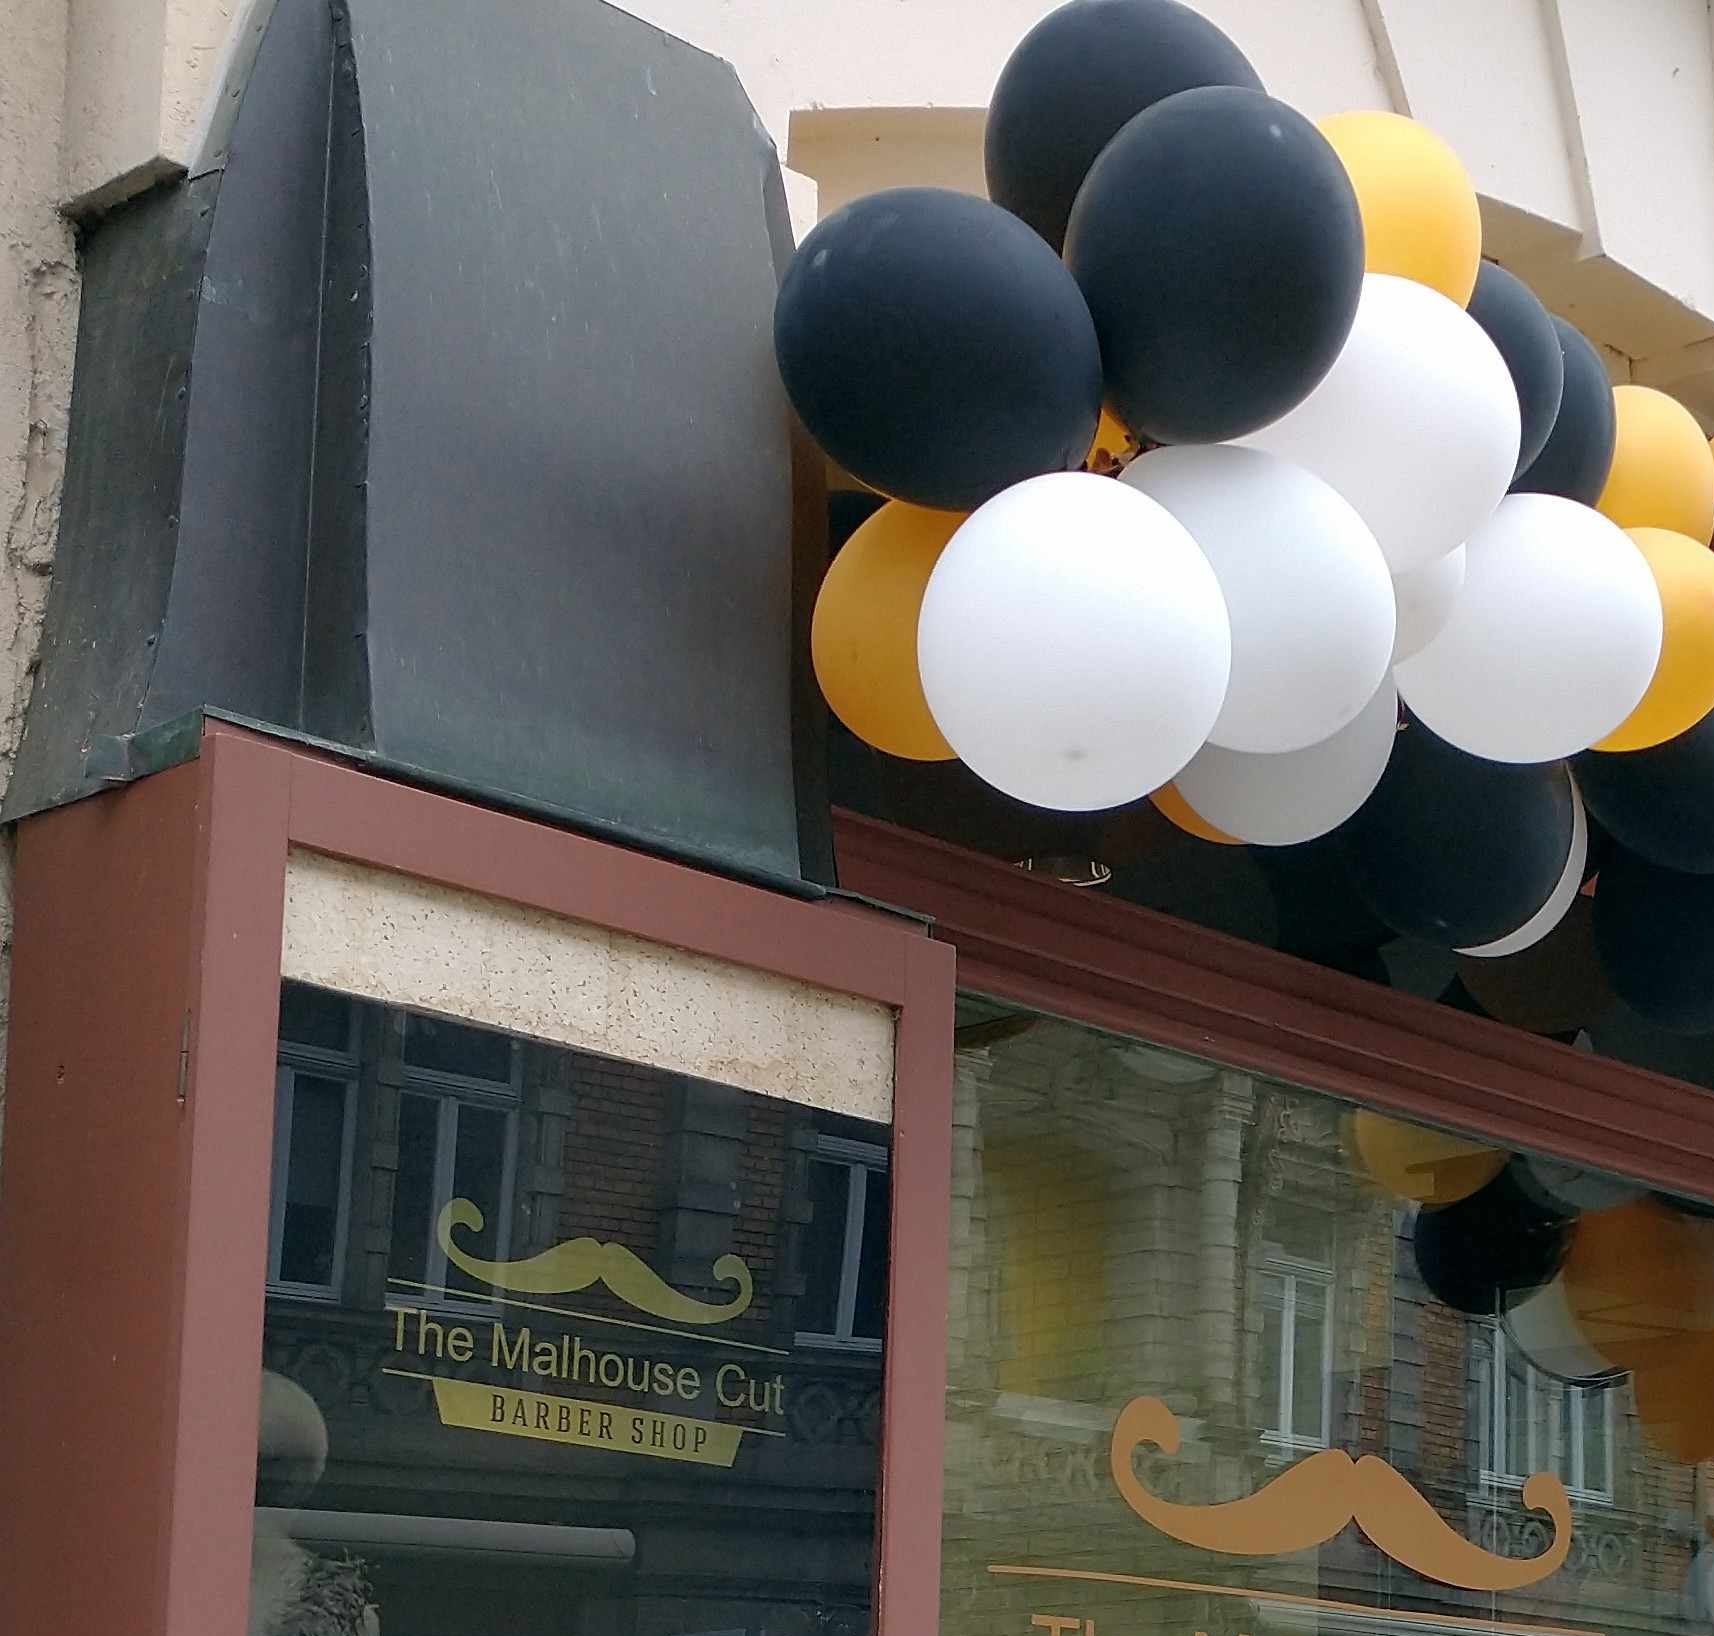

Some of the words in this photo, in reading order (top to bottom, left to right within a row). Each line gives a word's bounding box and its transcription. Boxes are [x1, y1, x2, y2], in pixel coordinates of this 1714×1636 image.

[391, 1307, 474, 1363] The
[491, 1321, 701, 1400] Malhouse
[715, 1363, 785, 1416] Cut
[491, 1394, 614, 1441] BARBER
[632, 1416, 709, 1454] SHOP
